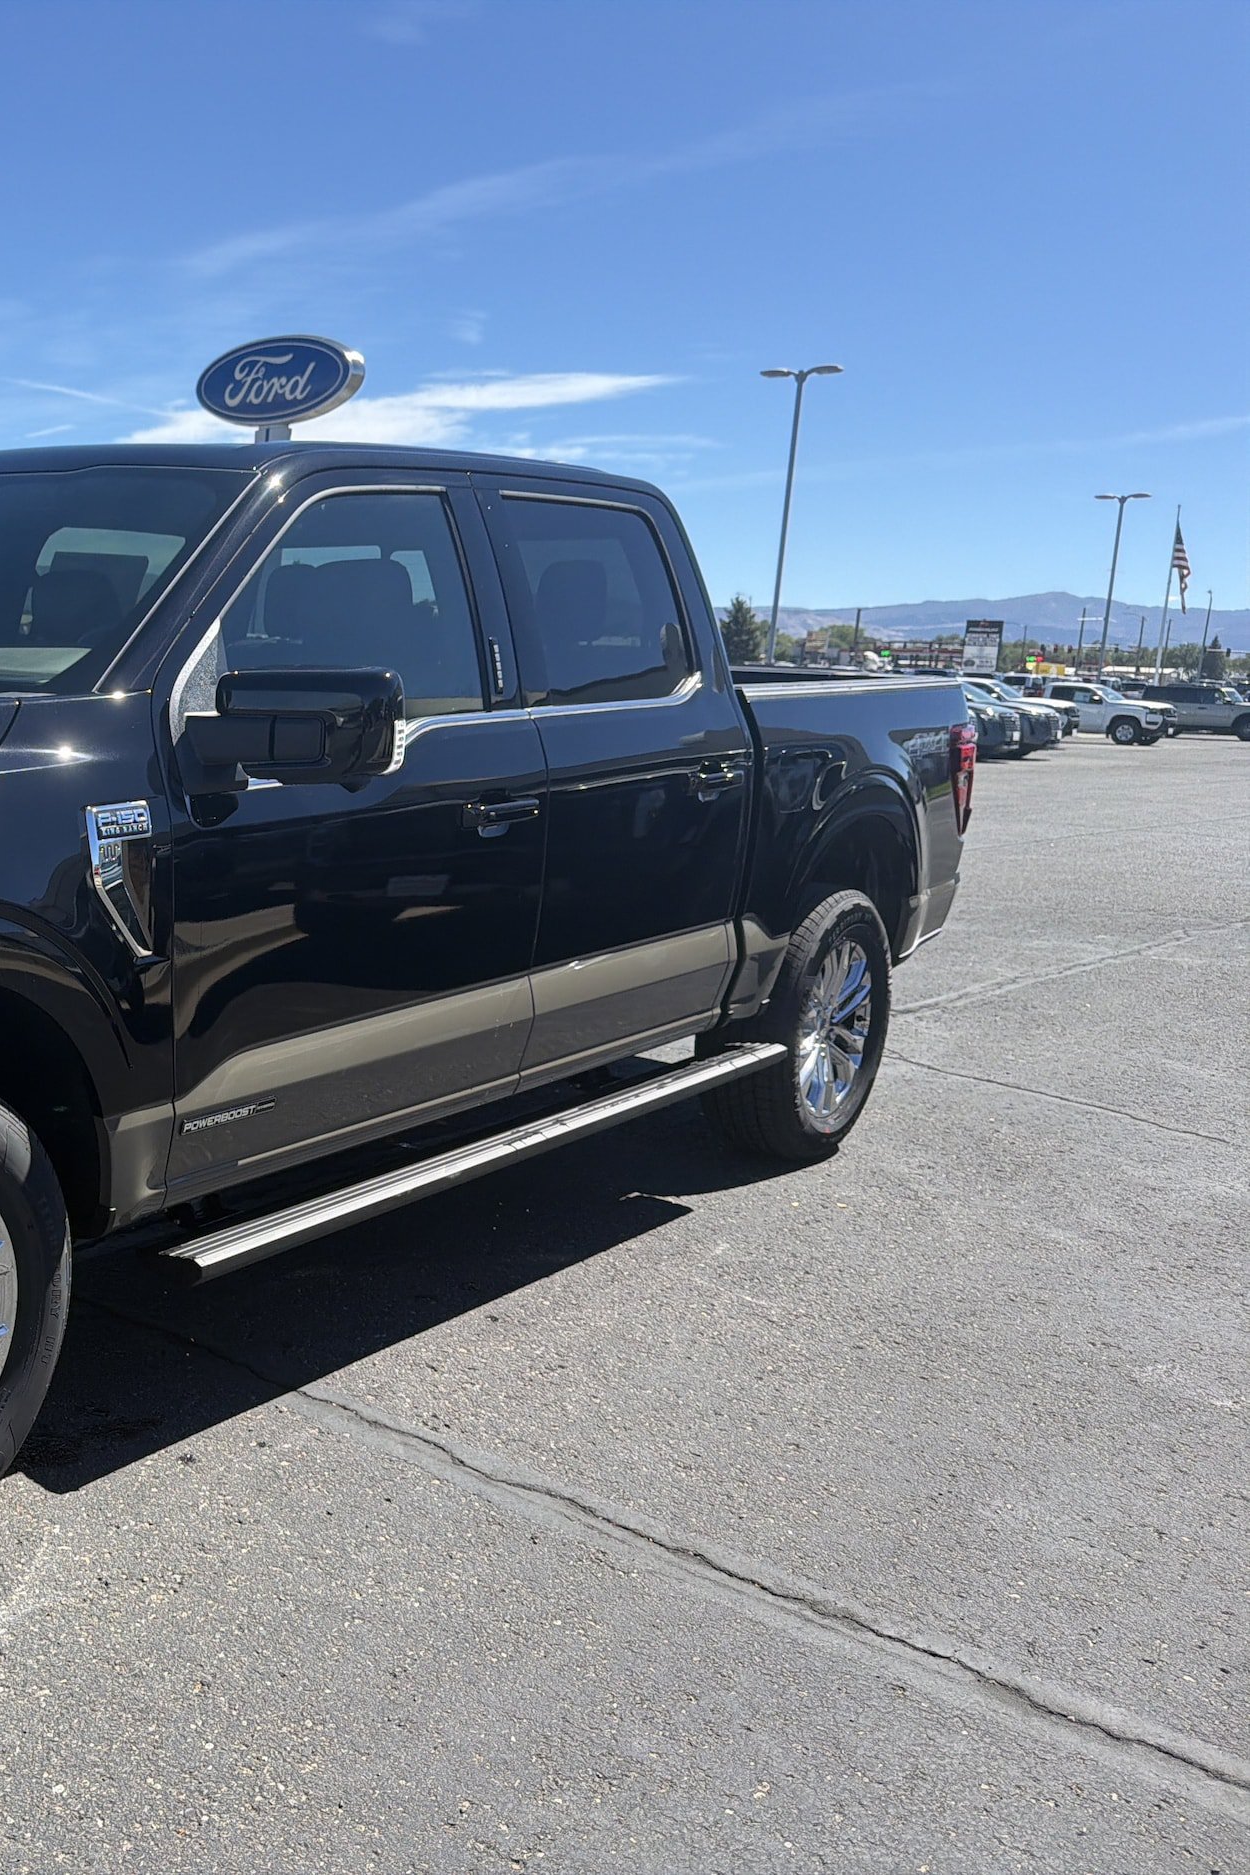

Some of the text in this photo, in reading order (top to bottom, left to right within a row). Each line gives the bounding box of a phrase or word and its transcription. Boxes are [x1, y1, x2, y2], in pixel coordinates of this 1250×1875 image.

[224, 352, 316, 408] Ford
[97, 808, 147, 827] F-150
[183, 1104, 257, 1133] POWERBOOST
